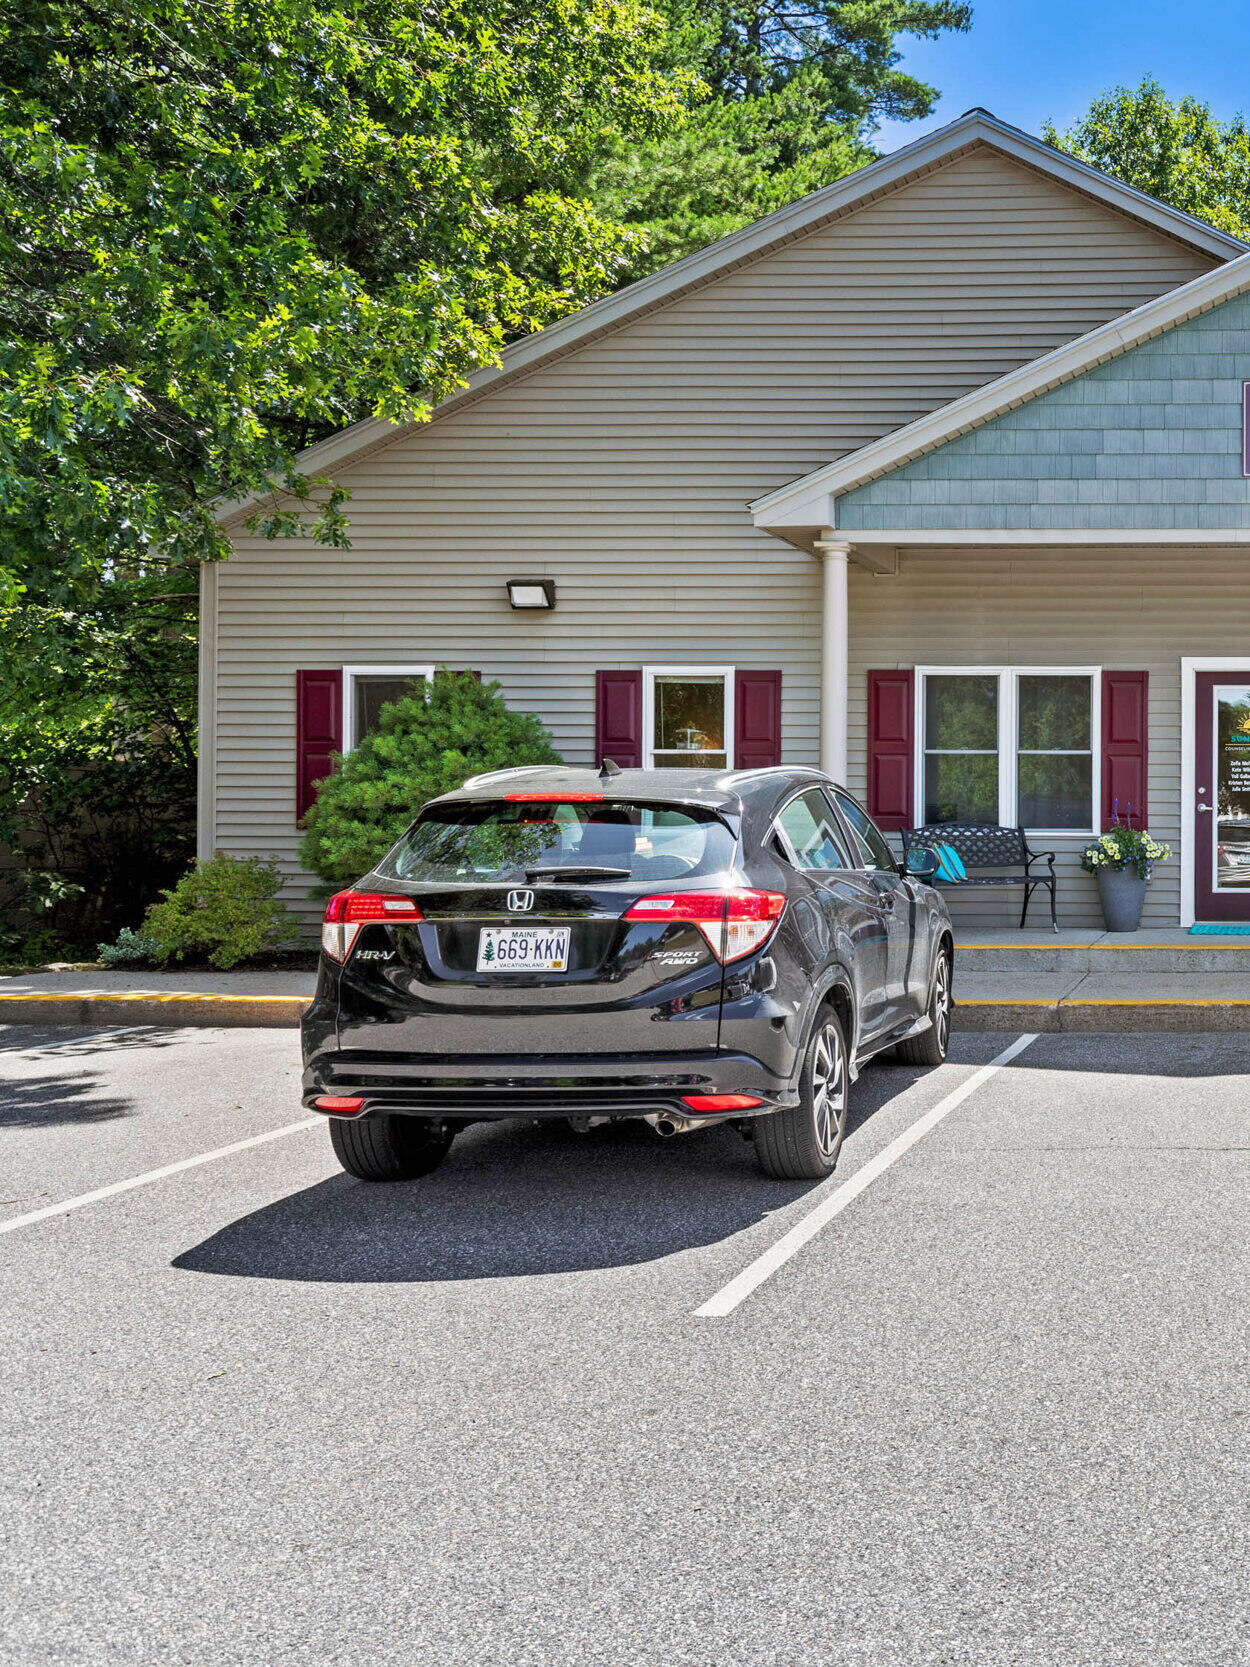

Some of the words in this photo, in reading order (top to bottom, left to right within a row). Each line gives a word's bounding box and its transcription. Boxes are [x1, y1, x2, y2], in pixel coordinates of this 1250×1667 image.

[355, 950, 396, 960] HR-V
[651, 950, 704, 958] SPORT
[660, 957, 698, 965] AWD
